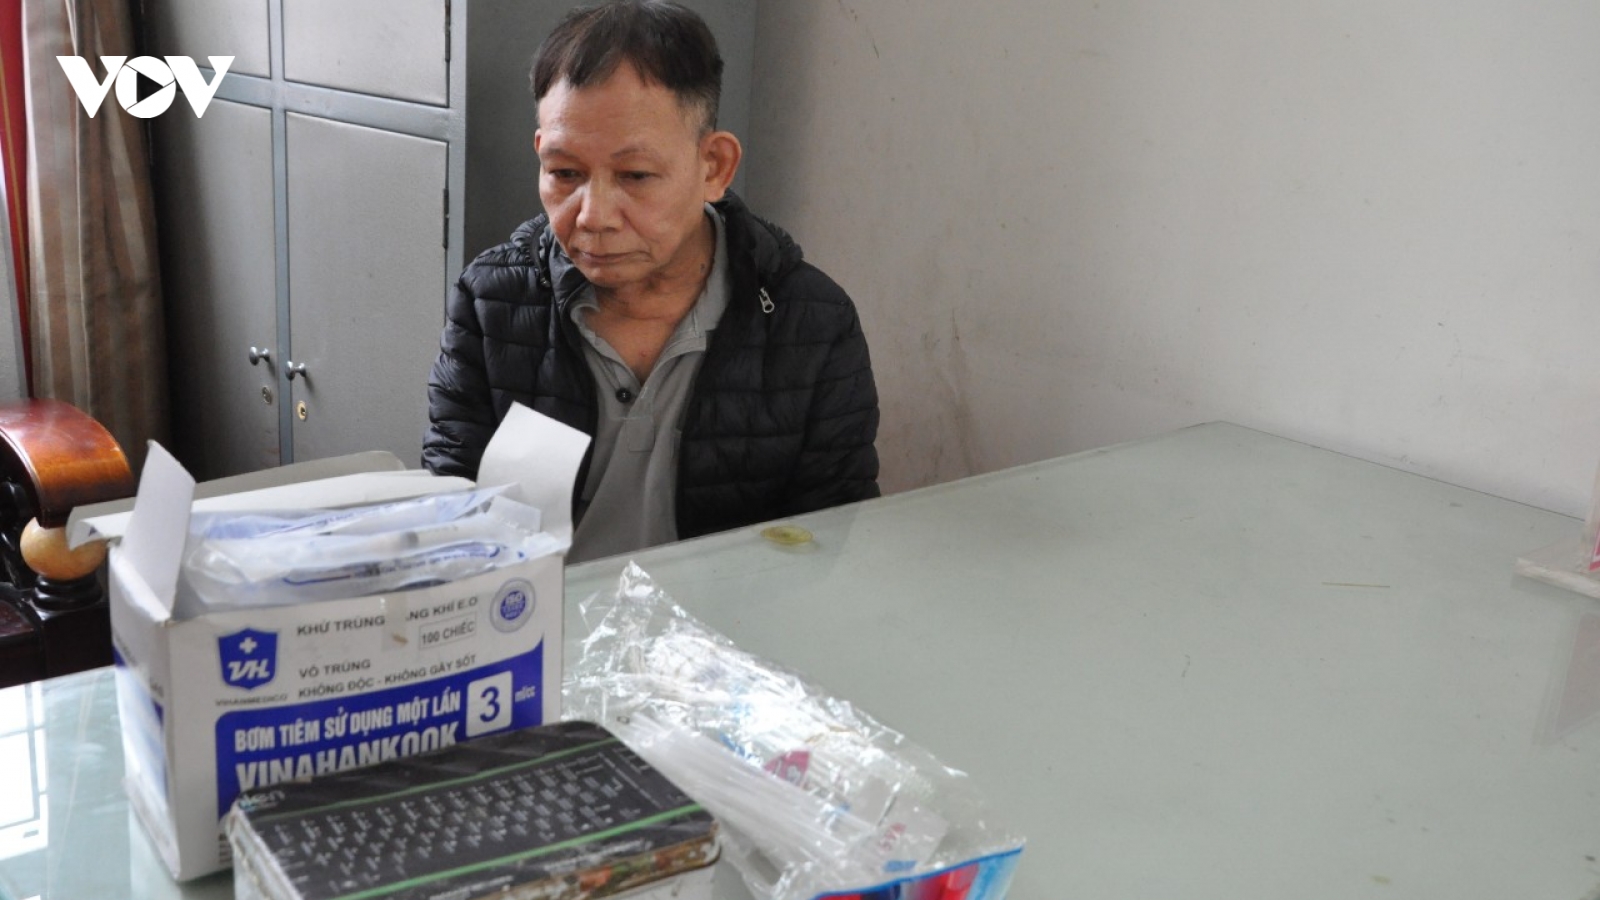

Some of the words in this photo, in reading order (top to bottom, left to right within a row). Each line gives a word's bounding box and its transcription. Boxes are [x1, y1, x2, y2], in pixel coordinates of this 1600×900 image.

[421, 629, 440, 645] 100
[299, 682, 345, 699] KHÔNG
[384, 666, 427, 685] KHÔNG
[479, 686, 501, 722] 3
[234, 726, 275, 753] BƠM
[279, 717, 320, 747] TIÊM
[324, 706, 349, 740] SỬ
[351, 705, 393, 737] DỤNG
[396, 695, 430, 726] MỘT
[234, 721, 460, 794] VINAHANKOOK
